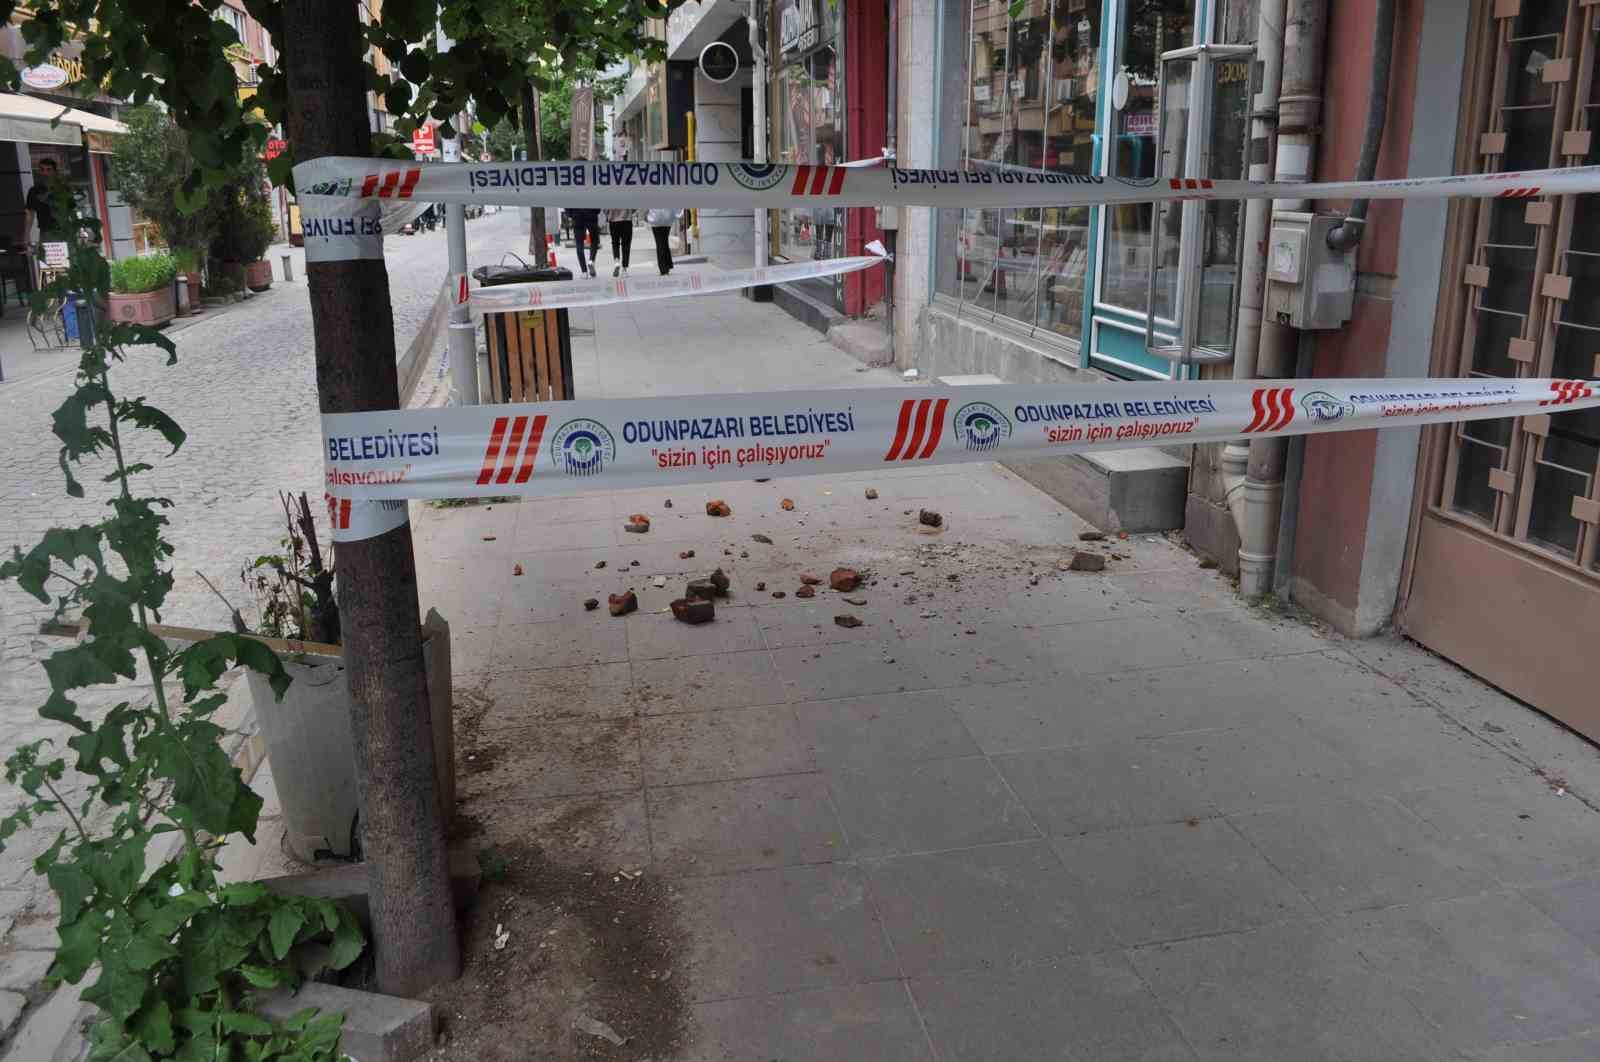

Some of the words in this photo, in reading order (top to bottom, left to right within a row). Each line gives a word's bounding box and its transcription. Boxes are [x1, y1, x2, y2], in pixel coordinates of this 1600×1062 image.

[468, 164, 585, 192] BELEDİYESİ
[592, 163, 719, 187] ODUNPAZARI
[1014, 402, 1121, 424] ODUNPAZARI
[1124, 393, 1216, 417] BELEDİYESİ
[622, 414, 744, 444] ODUNPAZARI
[748, 406, 854, 438] BELEDİYESİ
[1043, 423, 1082, 443] "sizin
[1086, 423, 1113, 441] için
[1116, 416, 1200, 441] çalışıyoruz"
[329, 425, 439, 461] BELEDİYESİ
[651, 448, 696, 469] "sizin
[702, 446, 732, 467] için
[736, 438, 832, 466] çalışıyoruz"
